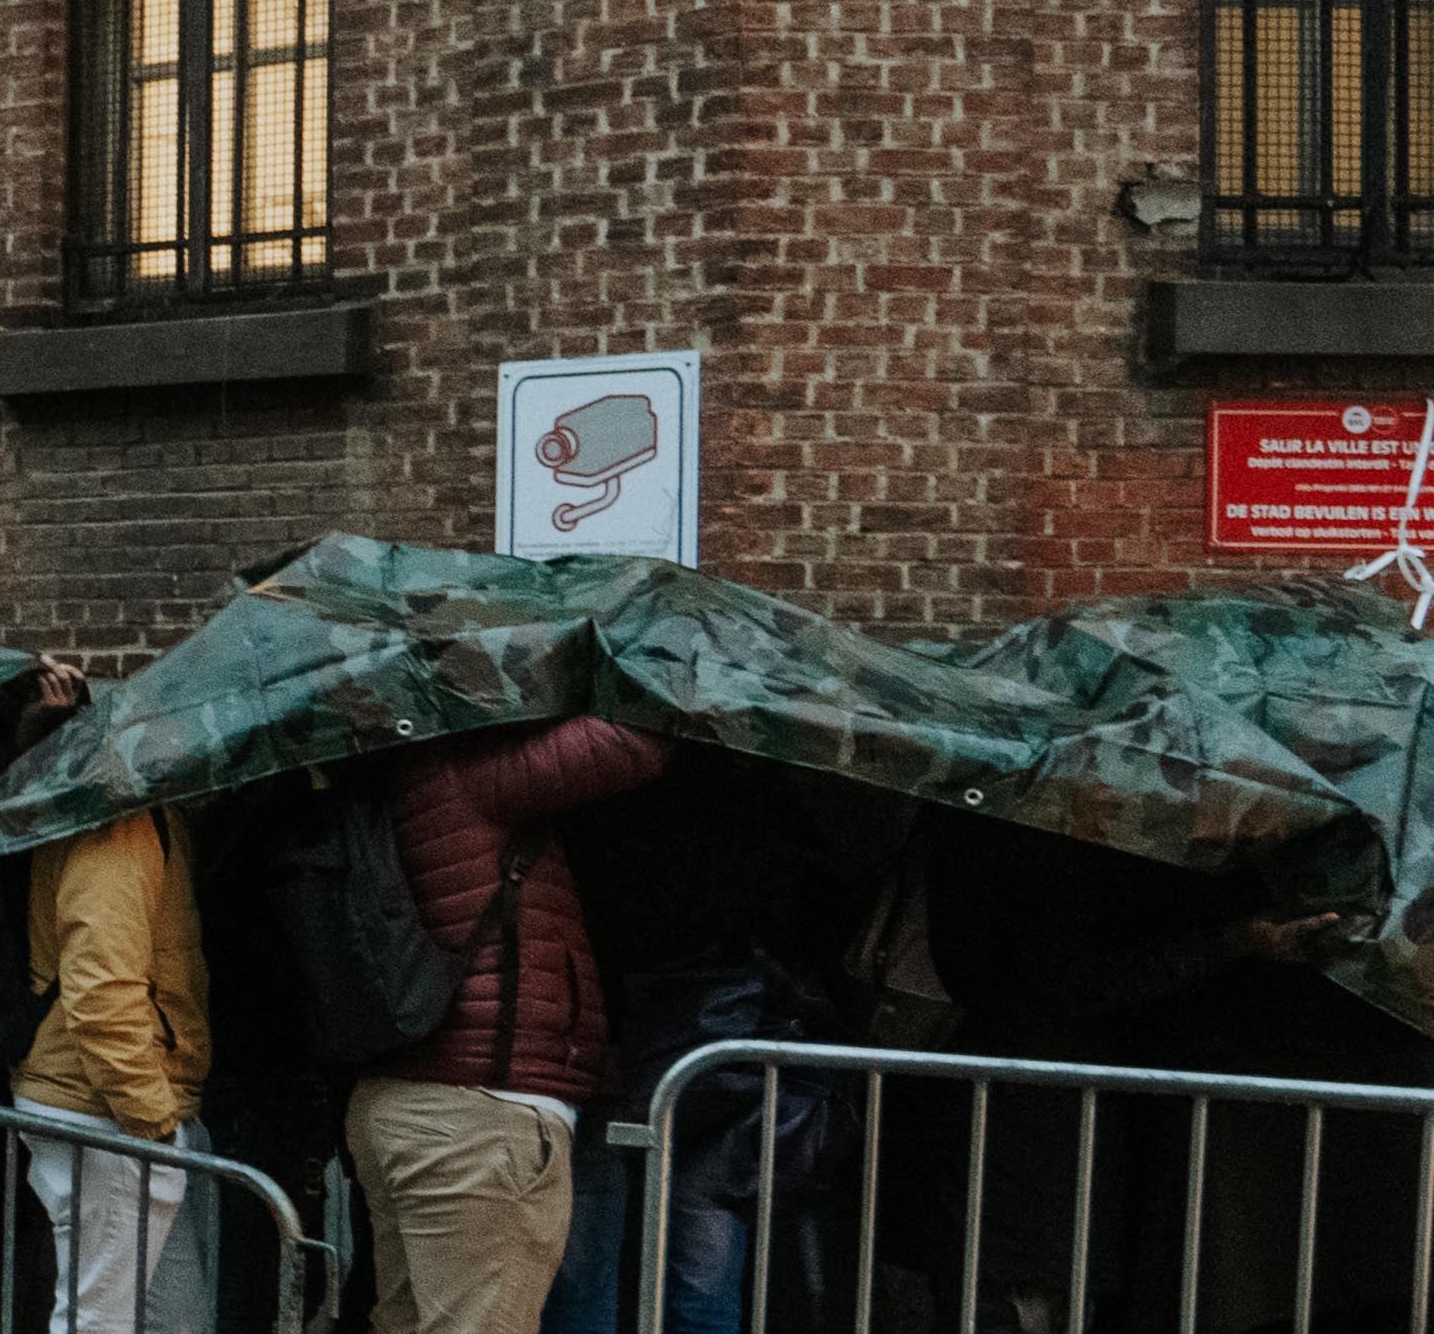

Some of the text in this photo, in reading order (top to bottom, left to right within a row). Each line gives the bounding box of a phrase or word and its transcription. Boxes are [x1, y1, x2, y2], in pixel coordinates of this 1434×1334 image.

[1259, 438, 1302, 454] SALIR
[1305, 440, 1325, 454] LA
[1328, 440, 1368, 454] VILLE
[1371, 440, 1399, 455] EST
[1226, 504, 1248, 519] DE
[1251, 504, 1291, 520] STAD
[1294, 505, 1369, 521] BEVUILEN
[1371, 506, 1387, 521] IS
